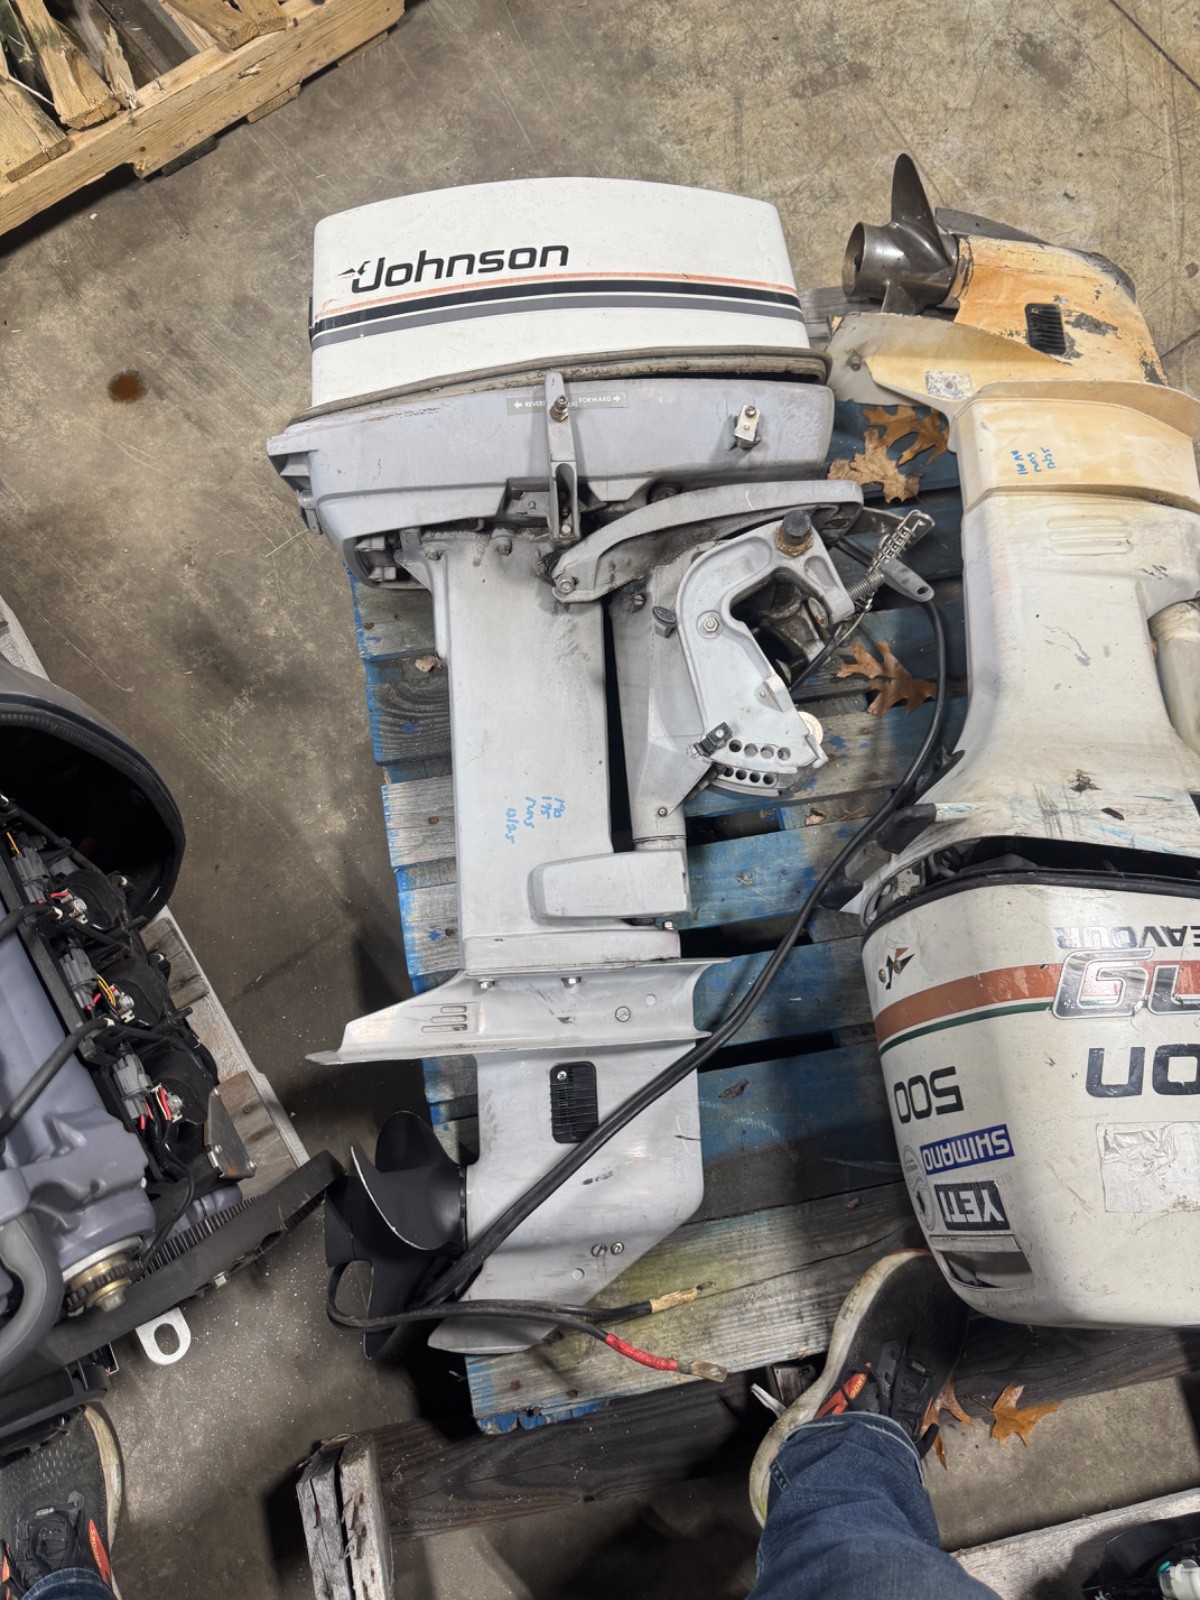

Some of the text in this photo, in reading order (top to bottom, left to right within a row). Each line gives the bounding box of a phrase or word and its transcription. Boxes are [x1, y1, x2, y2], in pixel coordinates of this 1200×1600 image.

[352, 245, 569, 294] Johnson
[578, 396, 612, 404] FORWARD
[894, 1066, 964, 1124] 500
[924, 1129, 1011, 1174] SHIMANO
[939, 1187, 1005, 1224] YETI
